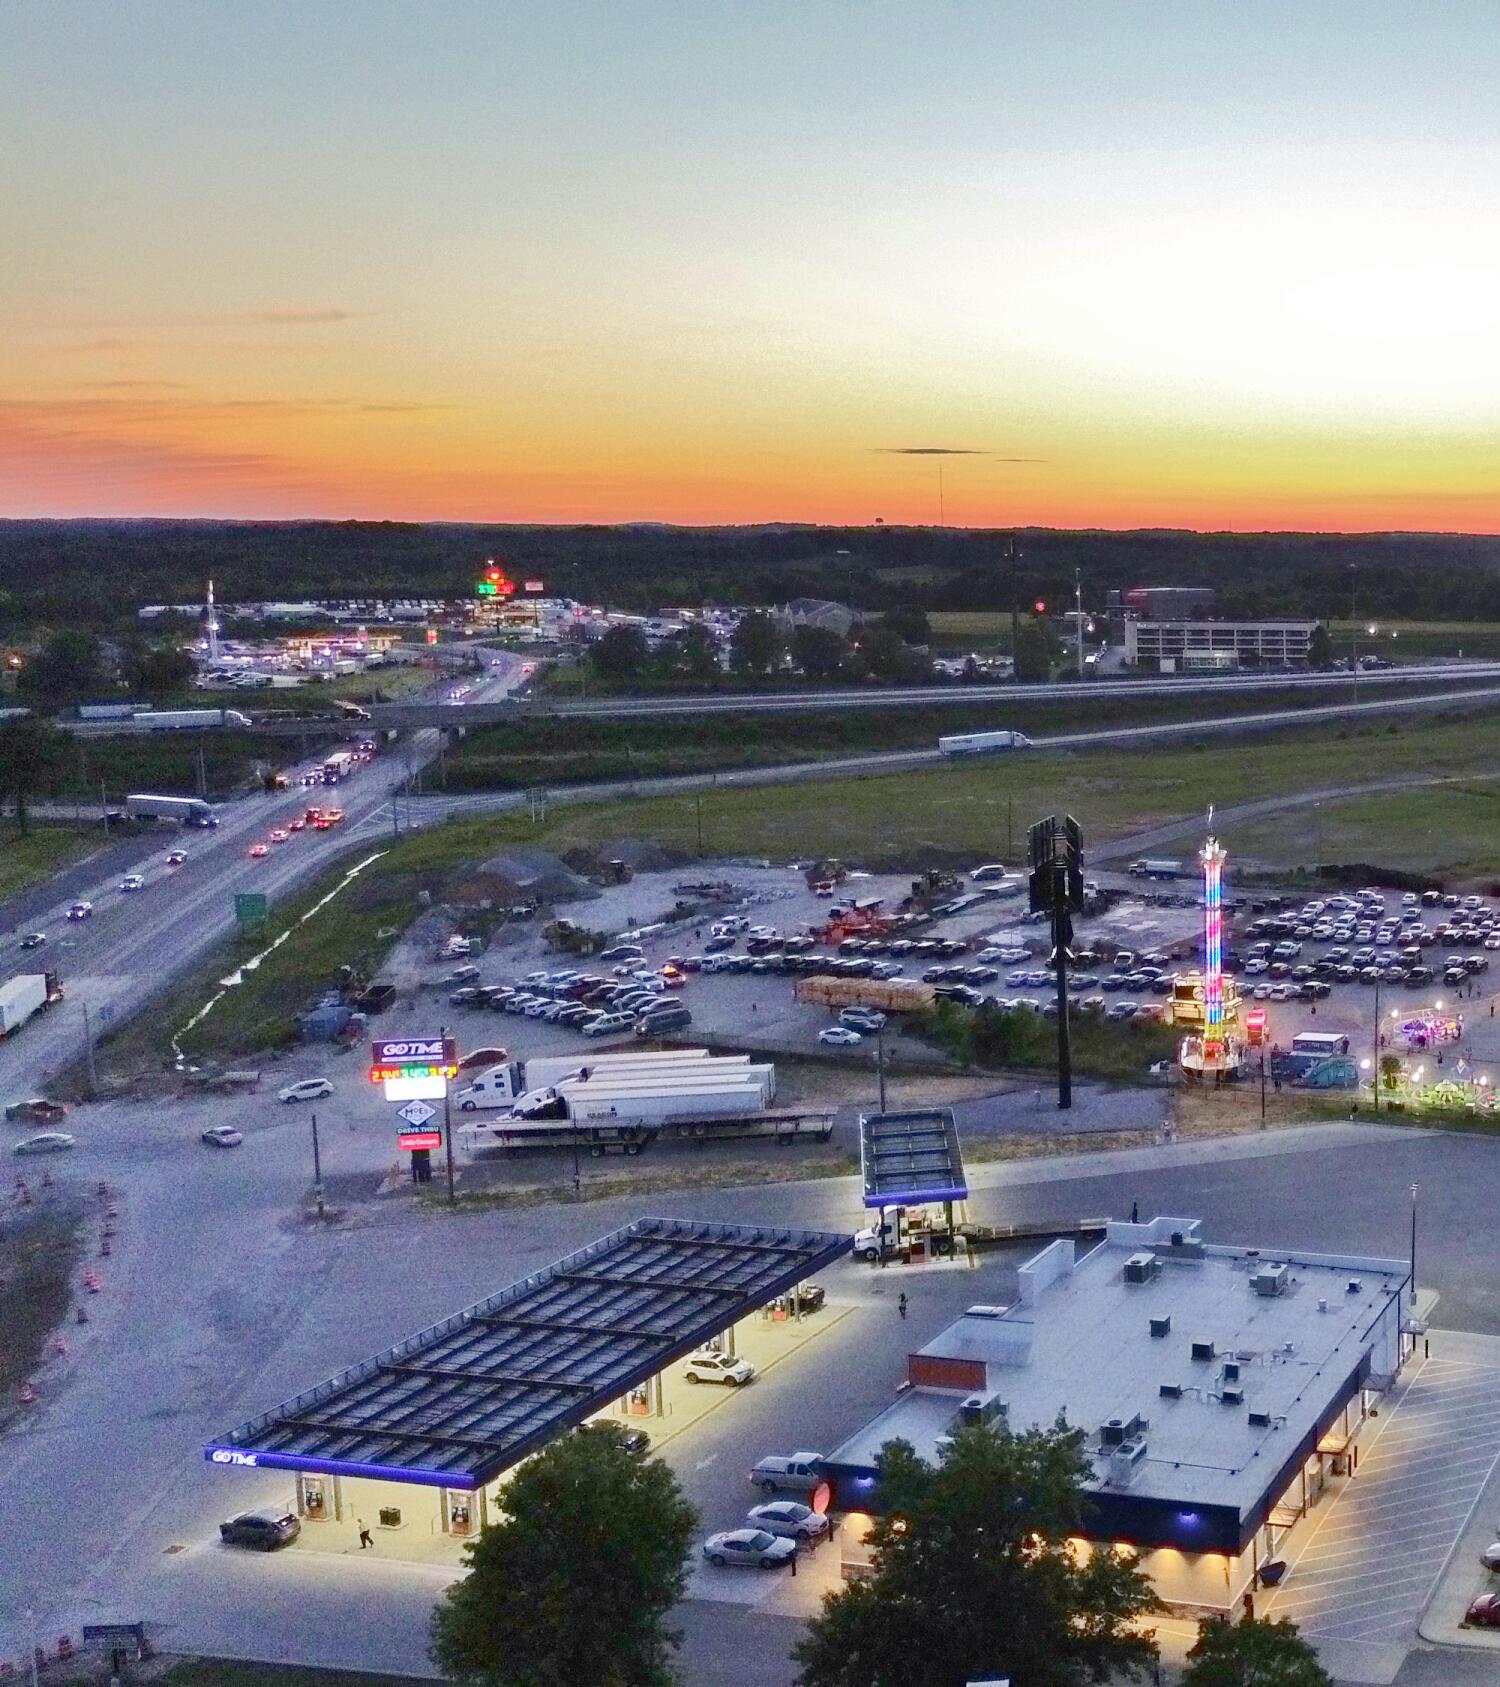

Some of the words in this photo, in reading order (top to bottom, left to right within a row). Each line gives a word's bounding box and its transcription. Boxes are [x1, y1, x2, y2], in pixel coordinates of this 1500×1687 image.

[383, 1043, 408, 1056] GO
[408, 1041, 443, 1055] TIME
[212, 1451, 231, 1463] GO
[231, 1453, 257, 1466] TIME
